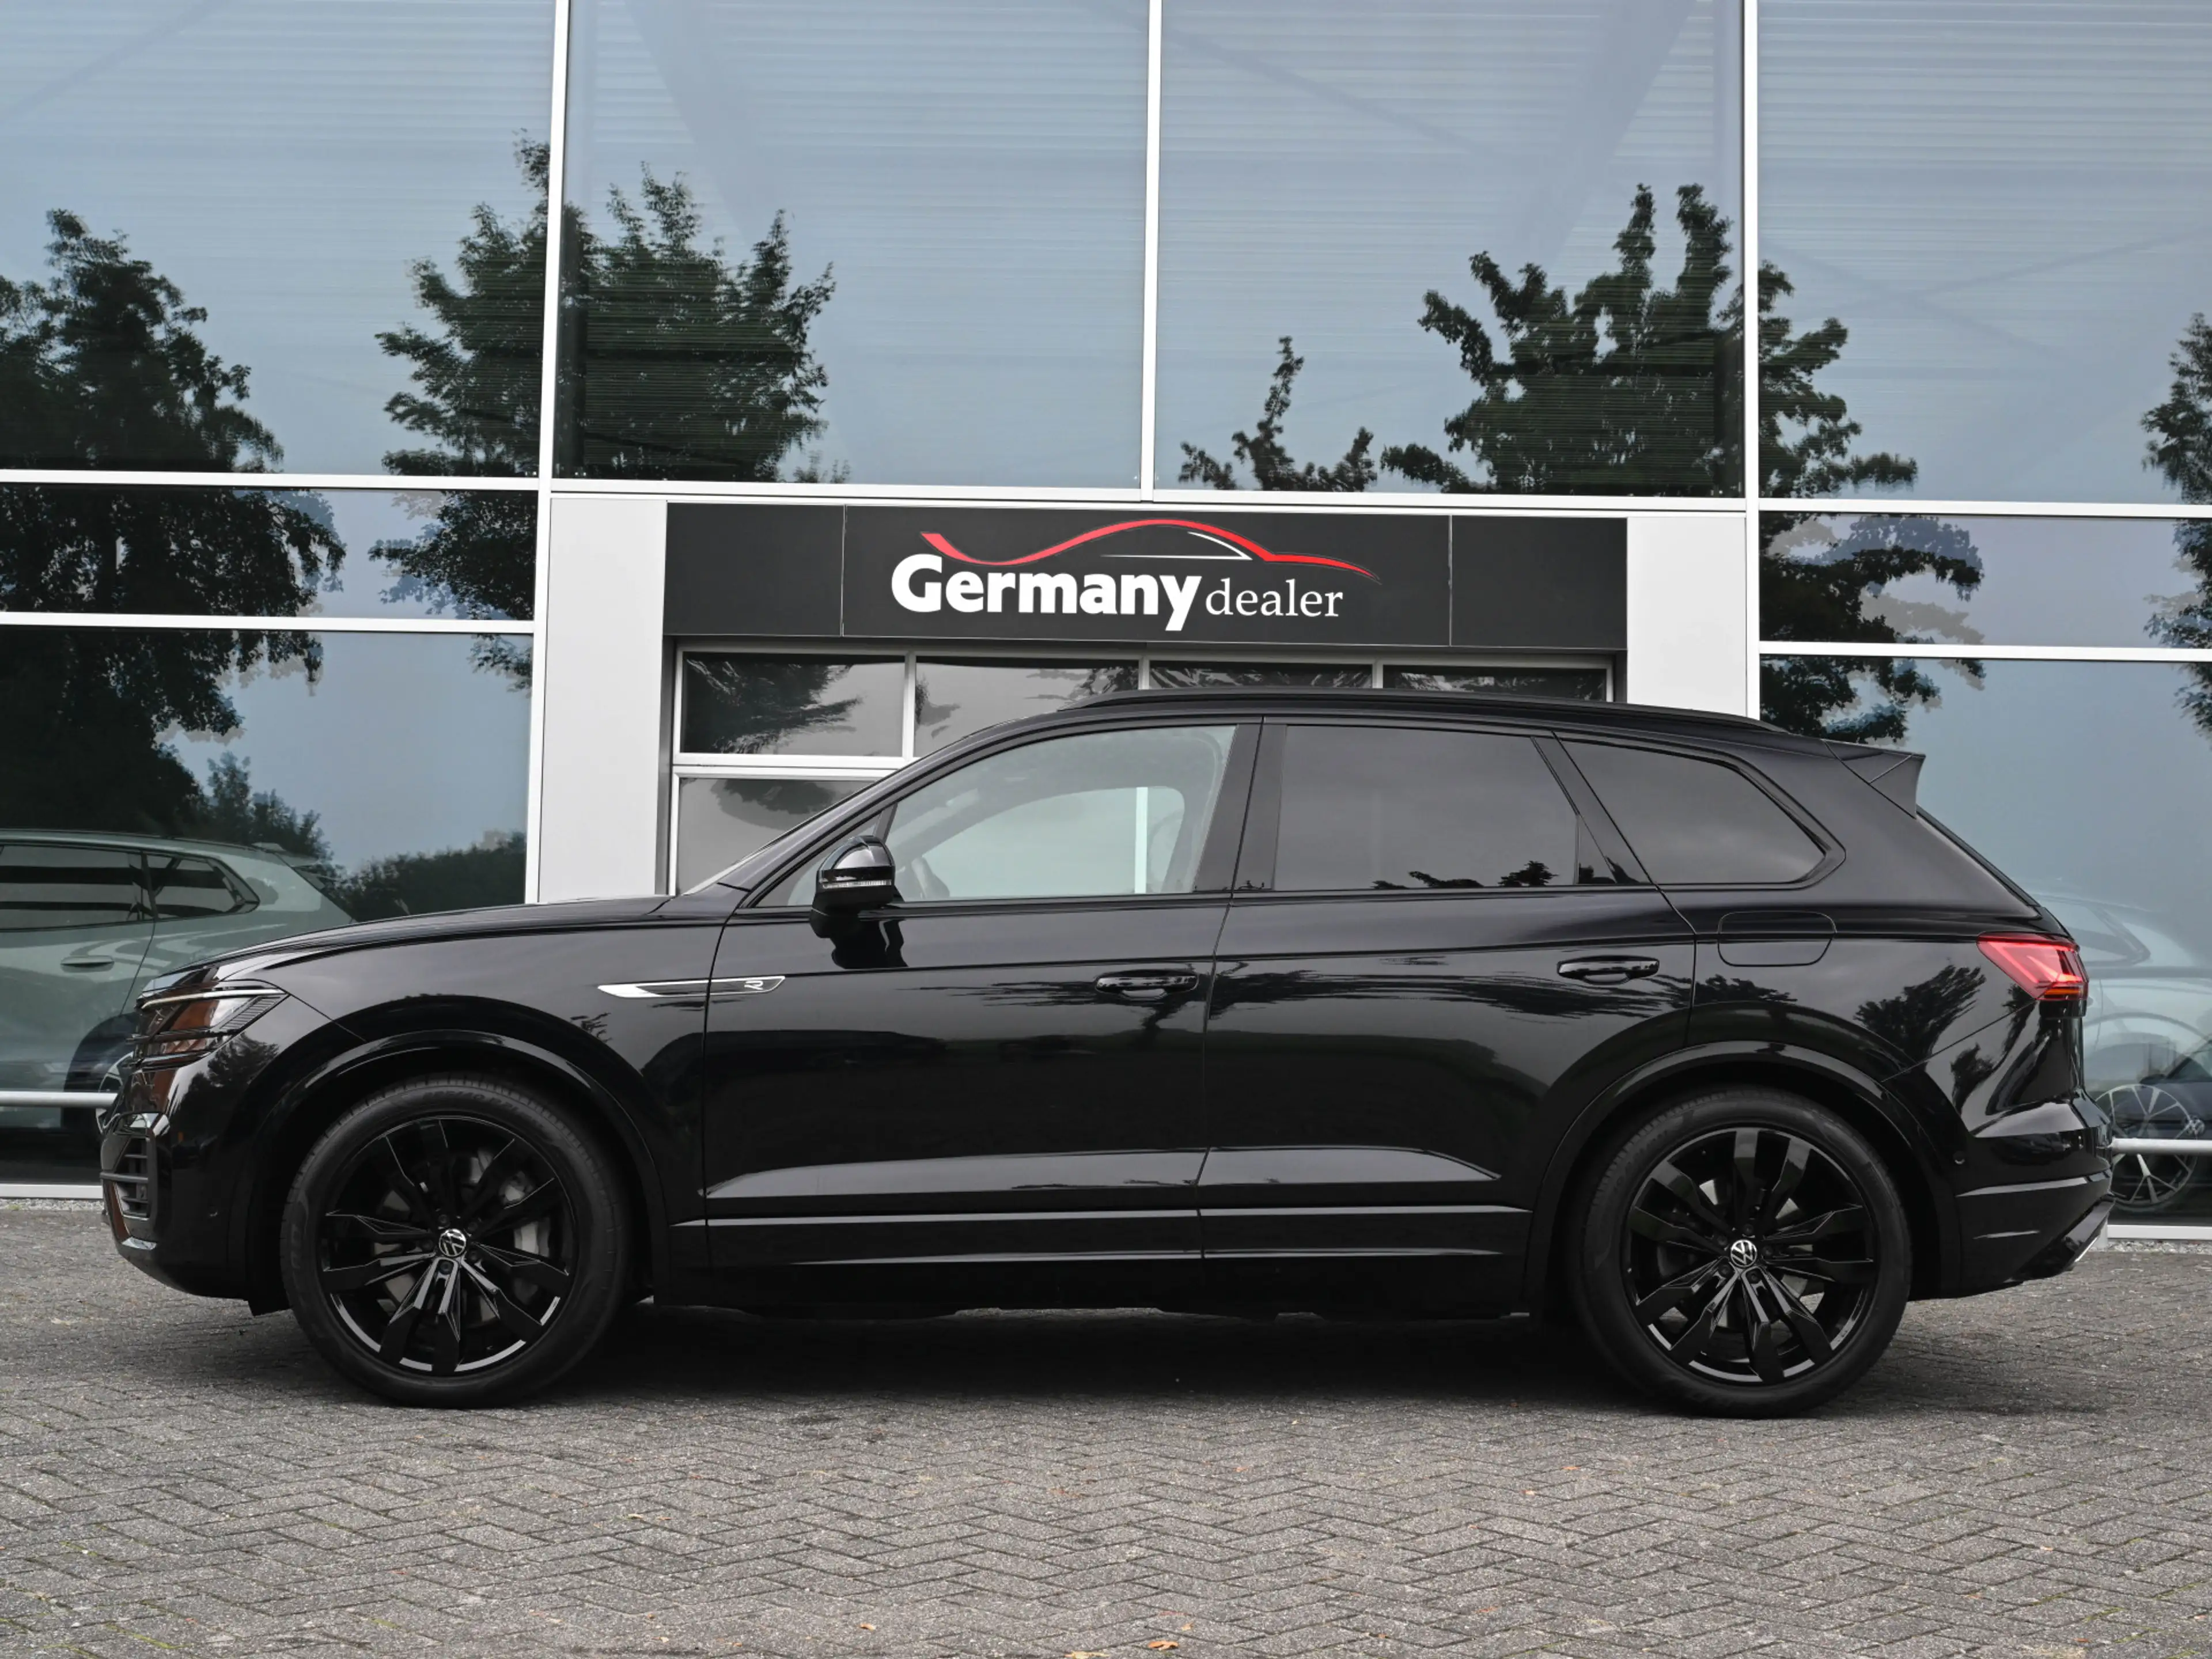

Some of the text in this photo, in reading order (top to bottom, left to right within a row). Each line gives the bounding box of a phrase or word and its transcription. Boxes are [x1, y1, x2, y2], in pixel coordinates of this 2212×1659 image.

[891, 554, 1343, 631] Germany dealer
[744, 980, 764, 991] R
